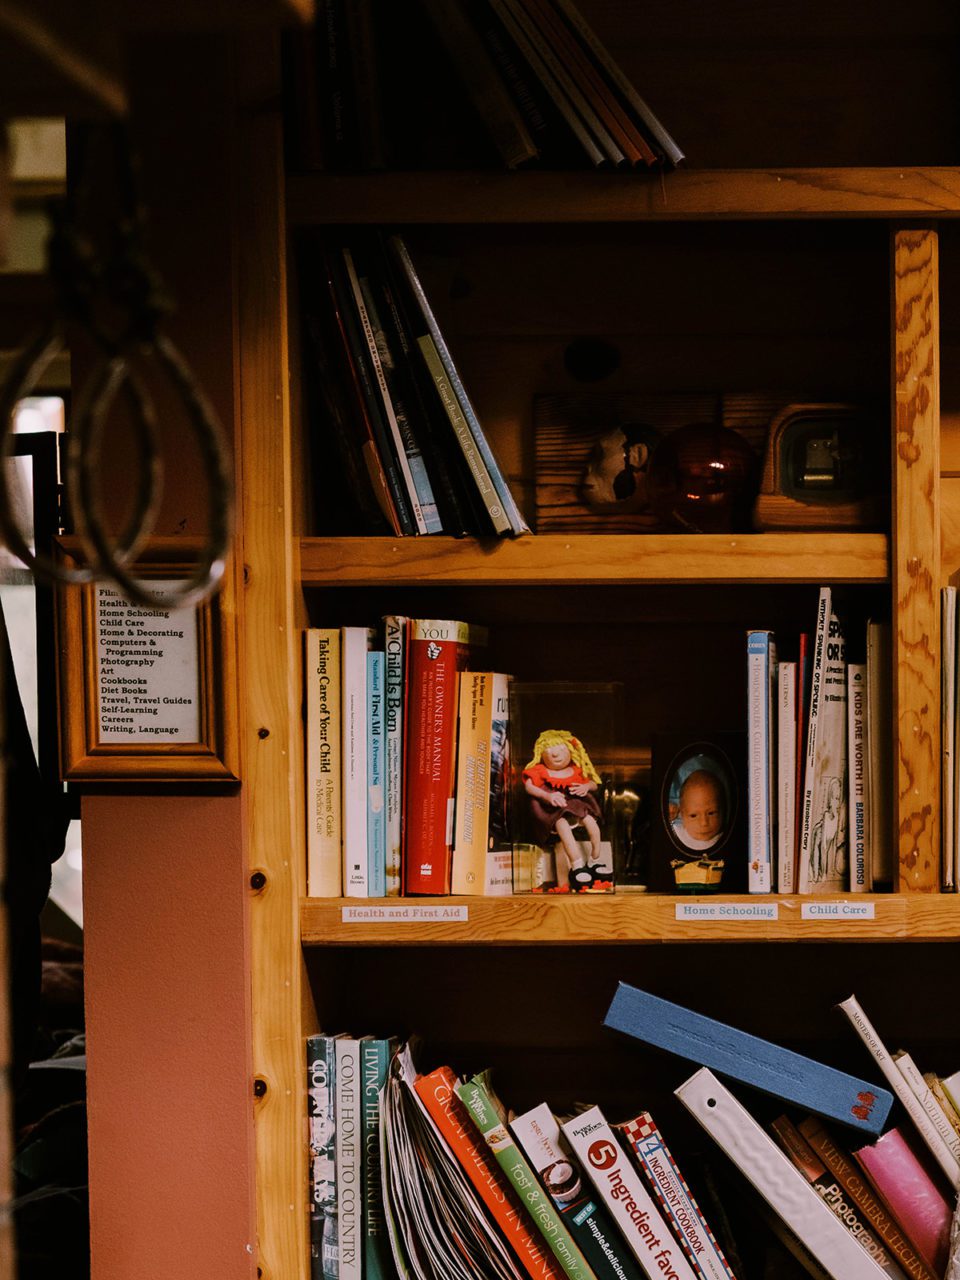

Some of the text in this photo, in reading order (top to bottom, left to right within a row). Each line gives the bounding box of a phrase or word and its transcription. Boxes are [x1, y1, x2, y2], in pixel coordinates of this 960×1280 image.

[100, 639, 147, 648] Computers
[136, 629, 184, 638] Decorating
[422, 628, 449, 640] YOU
[100, 658, 155, 666] Photography
[106, 648, 163, 658] Programming
[317, 638, 331, 773] Taking Care of Your Child
[102, 726, 179, 734] Writing, Language
[432, 664, 444, 781] THE OWNER'S MANUAL
[854, 692, 864, 796] KIDS ARE WORTH IT!
[856, 802, 864, 884] BARBARA COLOROSO
[349, 908, 460, 918] Health and First Aid
[684, 906, 774, 917] Home Schooling
[810, 906, 867, 914] Child Care
[364, 1048, 379, 1098] LIVING
[366, 1100, 380, 1128] THE
[340, 1054, 357, 1267] COME HOME TO COUNTRY
[590, 1144, 616, 1166] 5
[607, 1168, 660, 1251] Ingredient
[644, 1141, 706, 1256] 4 INGREDIENT COOKBOOK
[368, 1210, 380, 1237] LIFE
[823, 1183, 891, 1268] Photography
